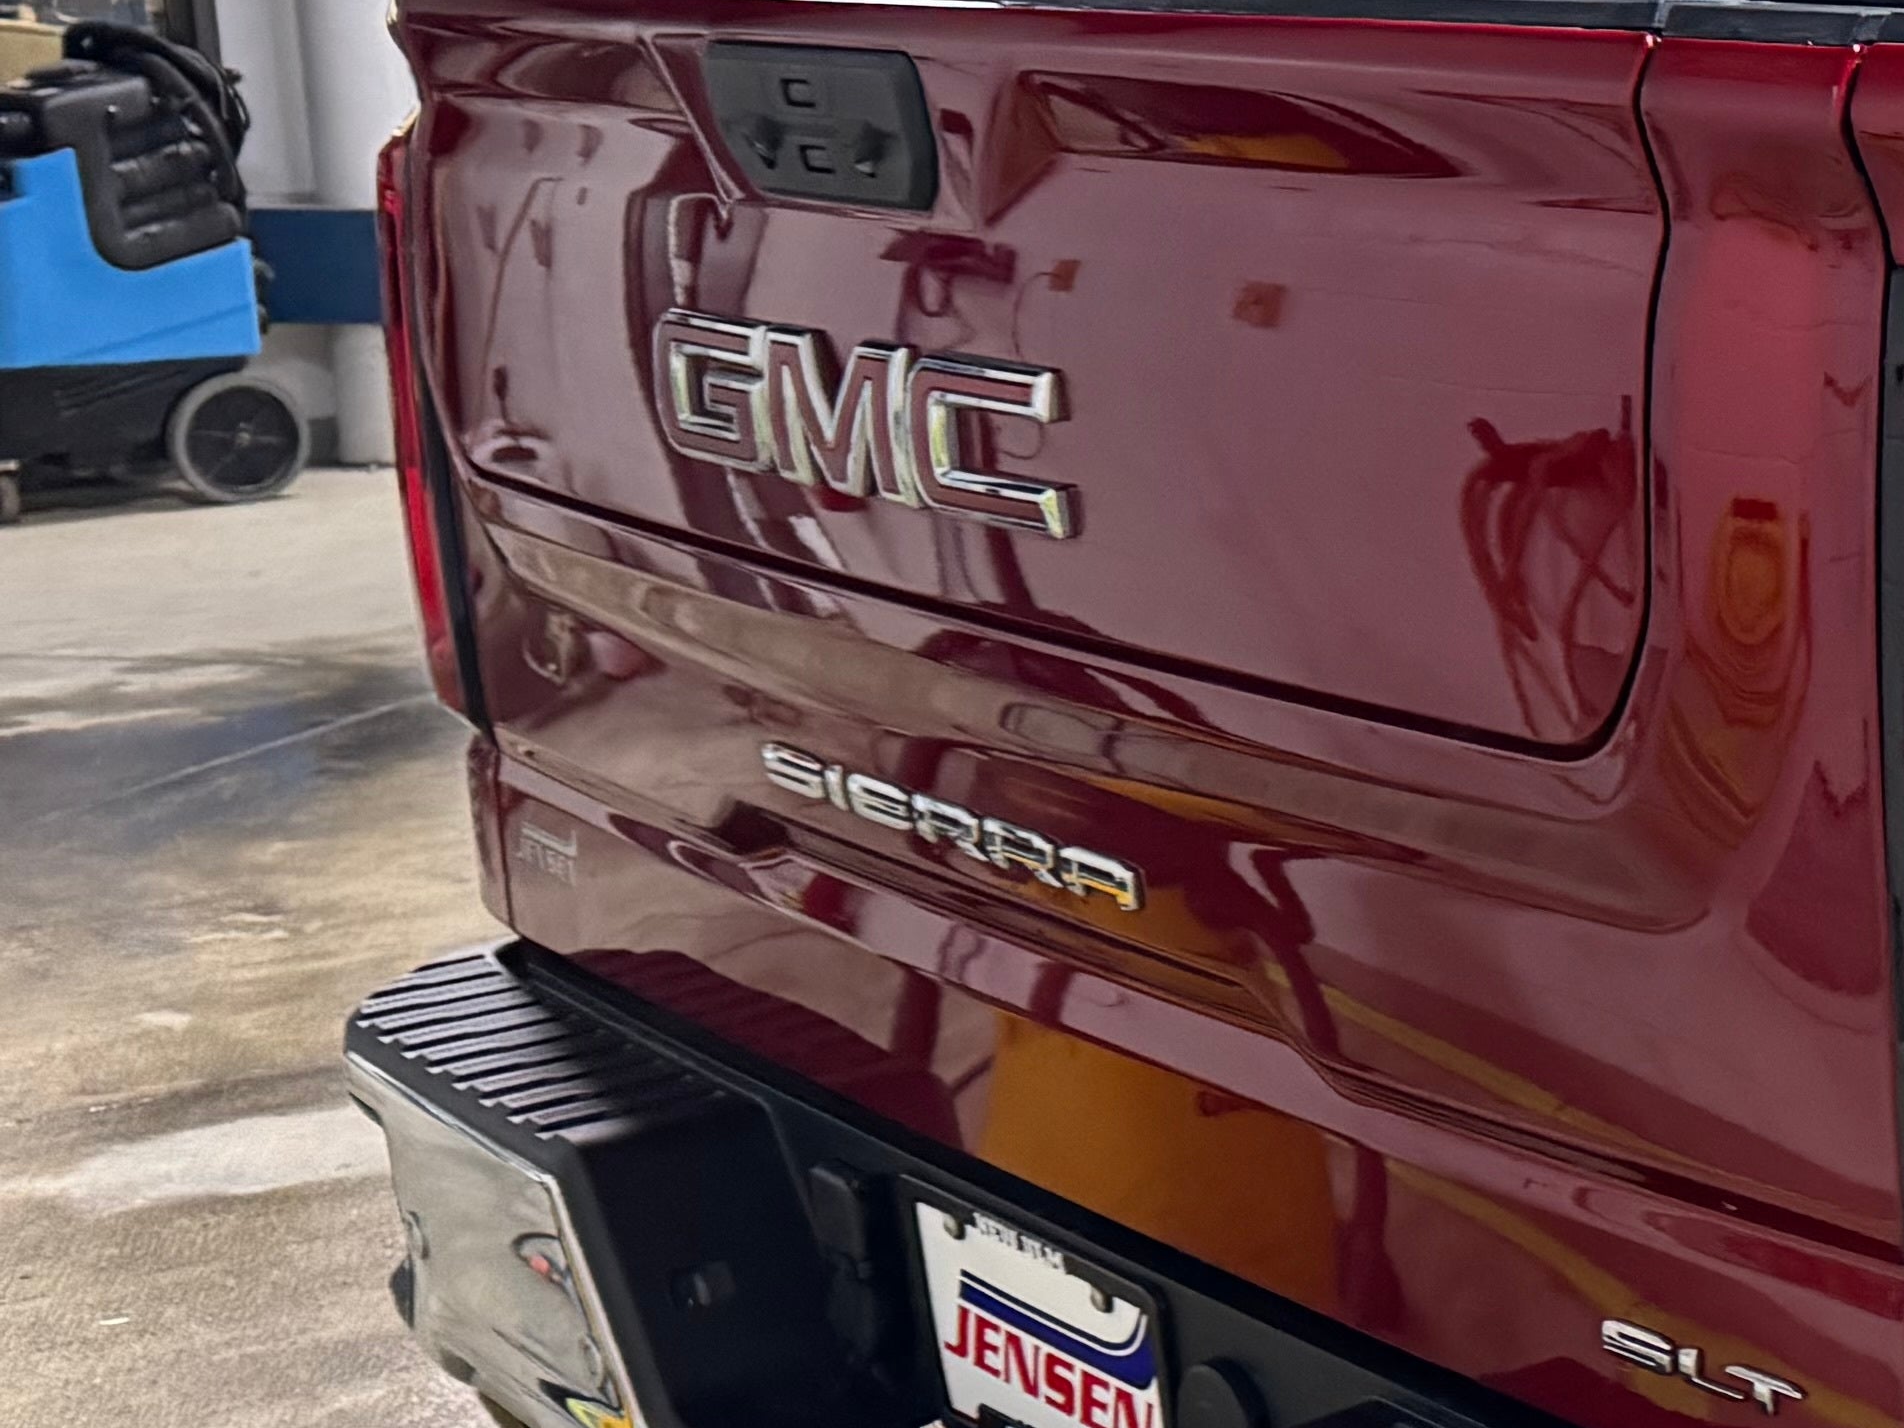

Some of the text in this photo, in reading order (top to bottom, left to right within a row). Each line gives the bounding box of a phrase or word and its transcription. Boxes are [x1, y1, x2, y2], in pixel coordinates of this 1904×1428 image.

[653, 307, 1080, 540] GMC
[760, 740, 1143, 913] SIERRA
[1601, 1318, 1804, 1416] SLT
